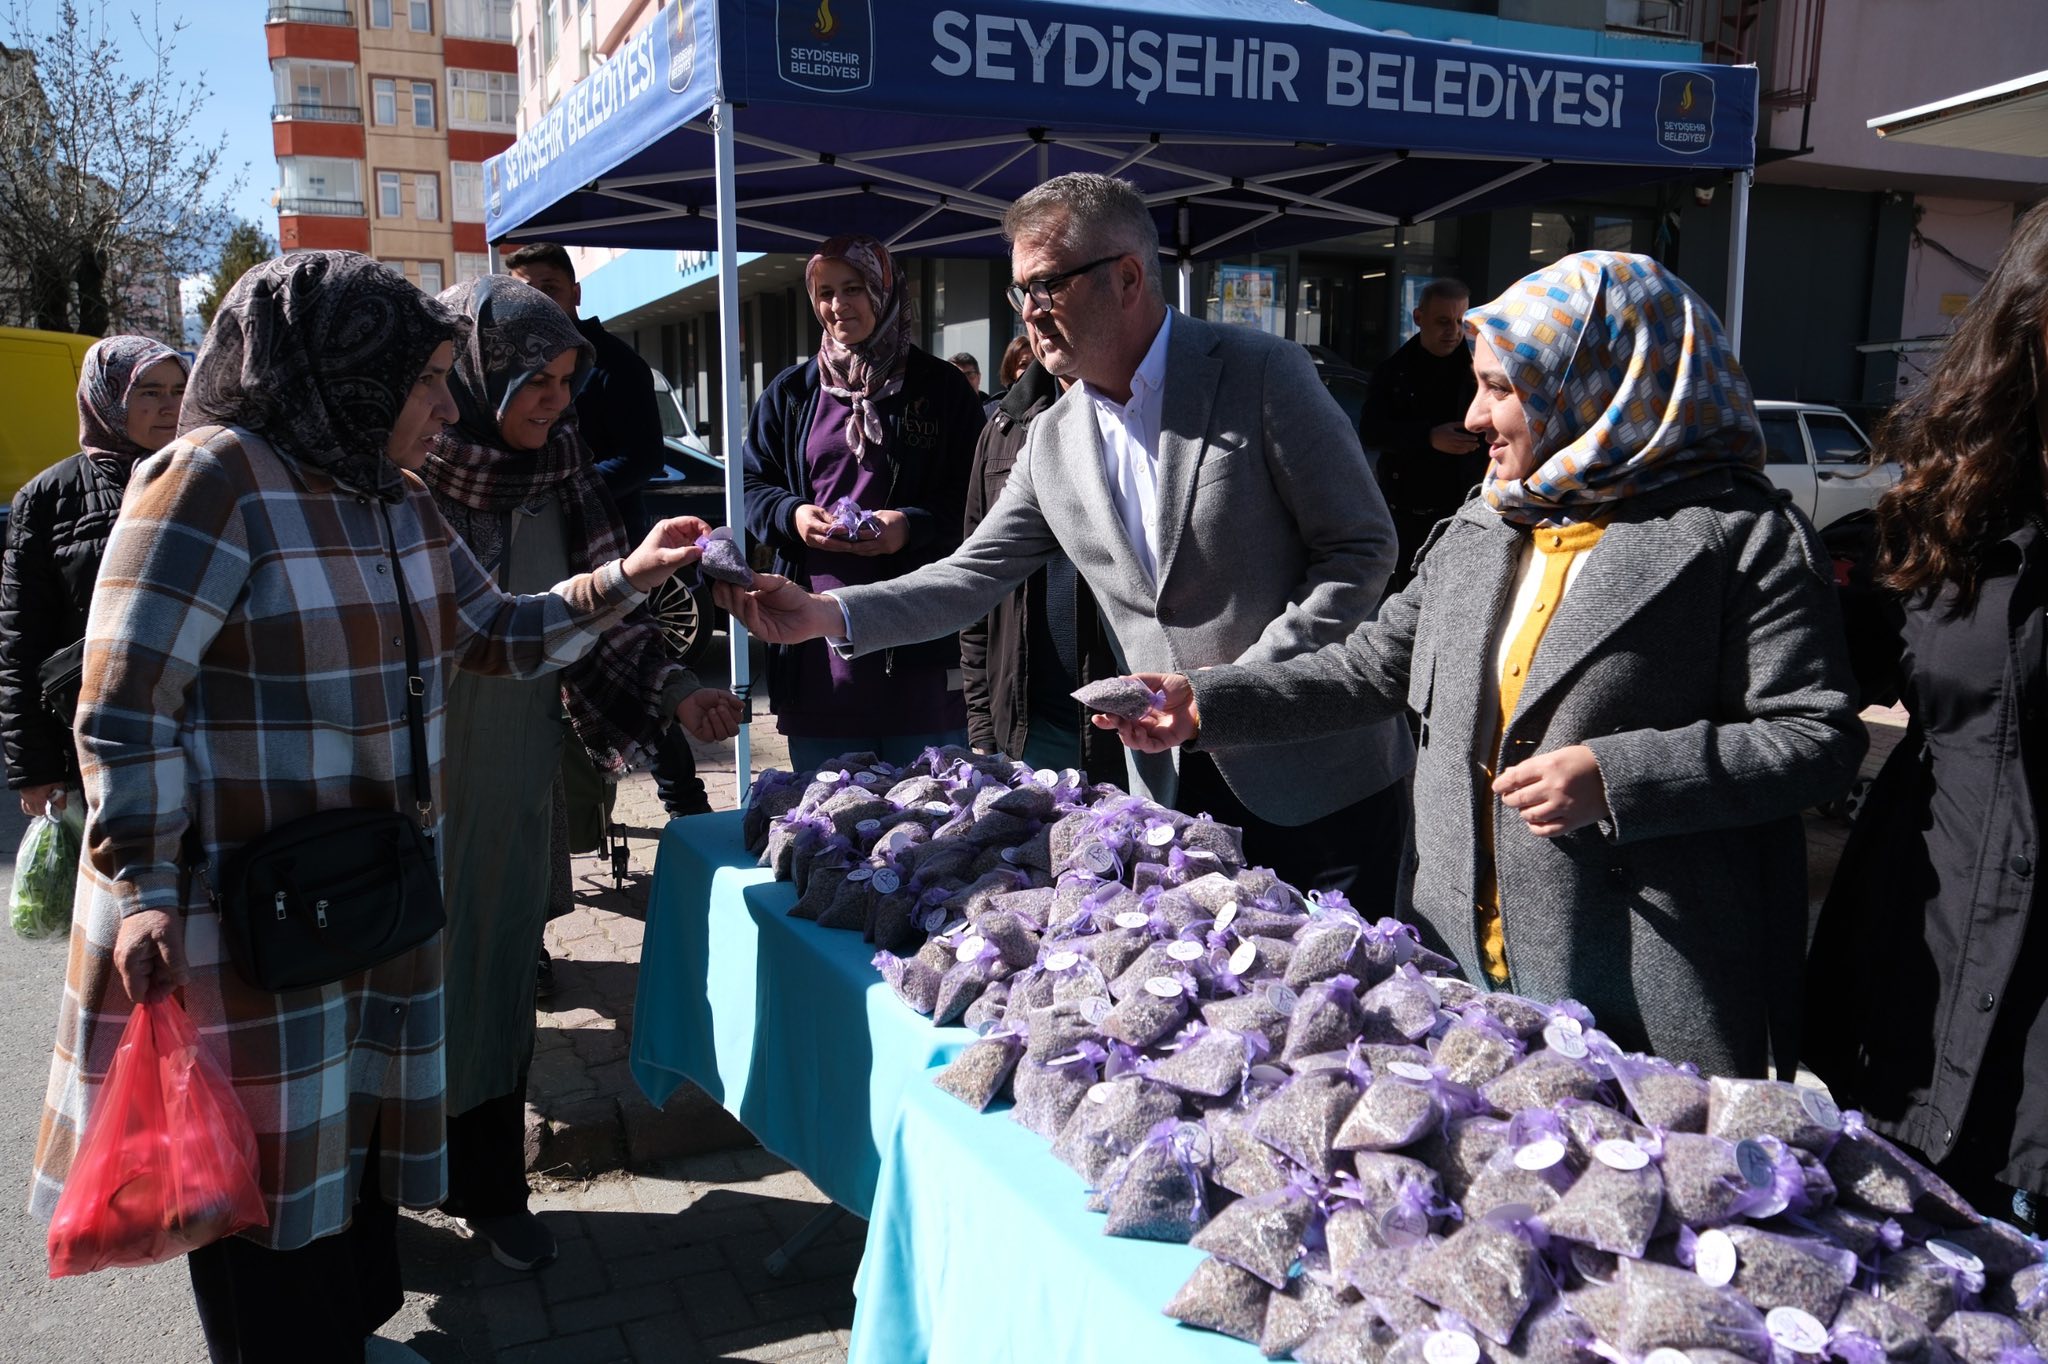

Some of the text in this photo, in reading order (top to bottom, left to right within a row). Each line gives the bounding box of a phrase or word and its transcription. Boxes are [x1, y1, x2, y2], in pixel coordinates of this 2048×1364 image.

[790, 47, 860, 65] SEYDİŞEHİR
[790, 62, 861, 79] BELEDİYESİ
[930, 10, 1625, 128] SEYDİŞEHİR BELEDİYESİ
